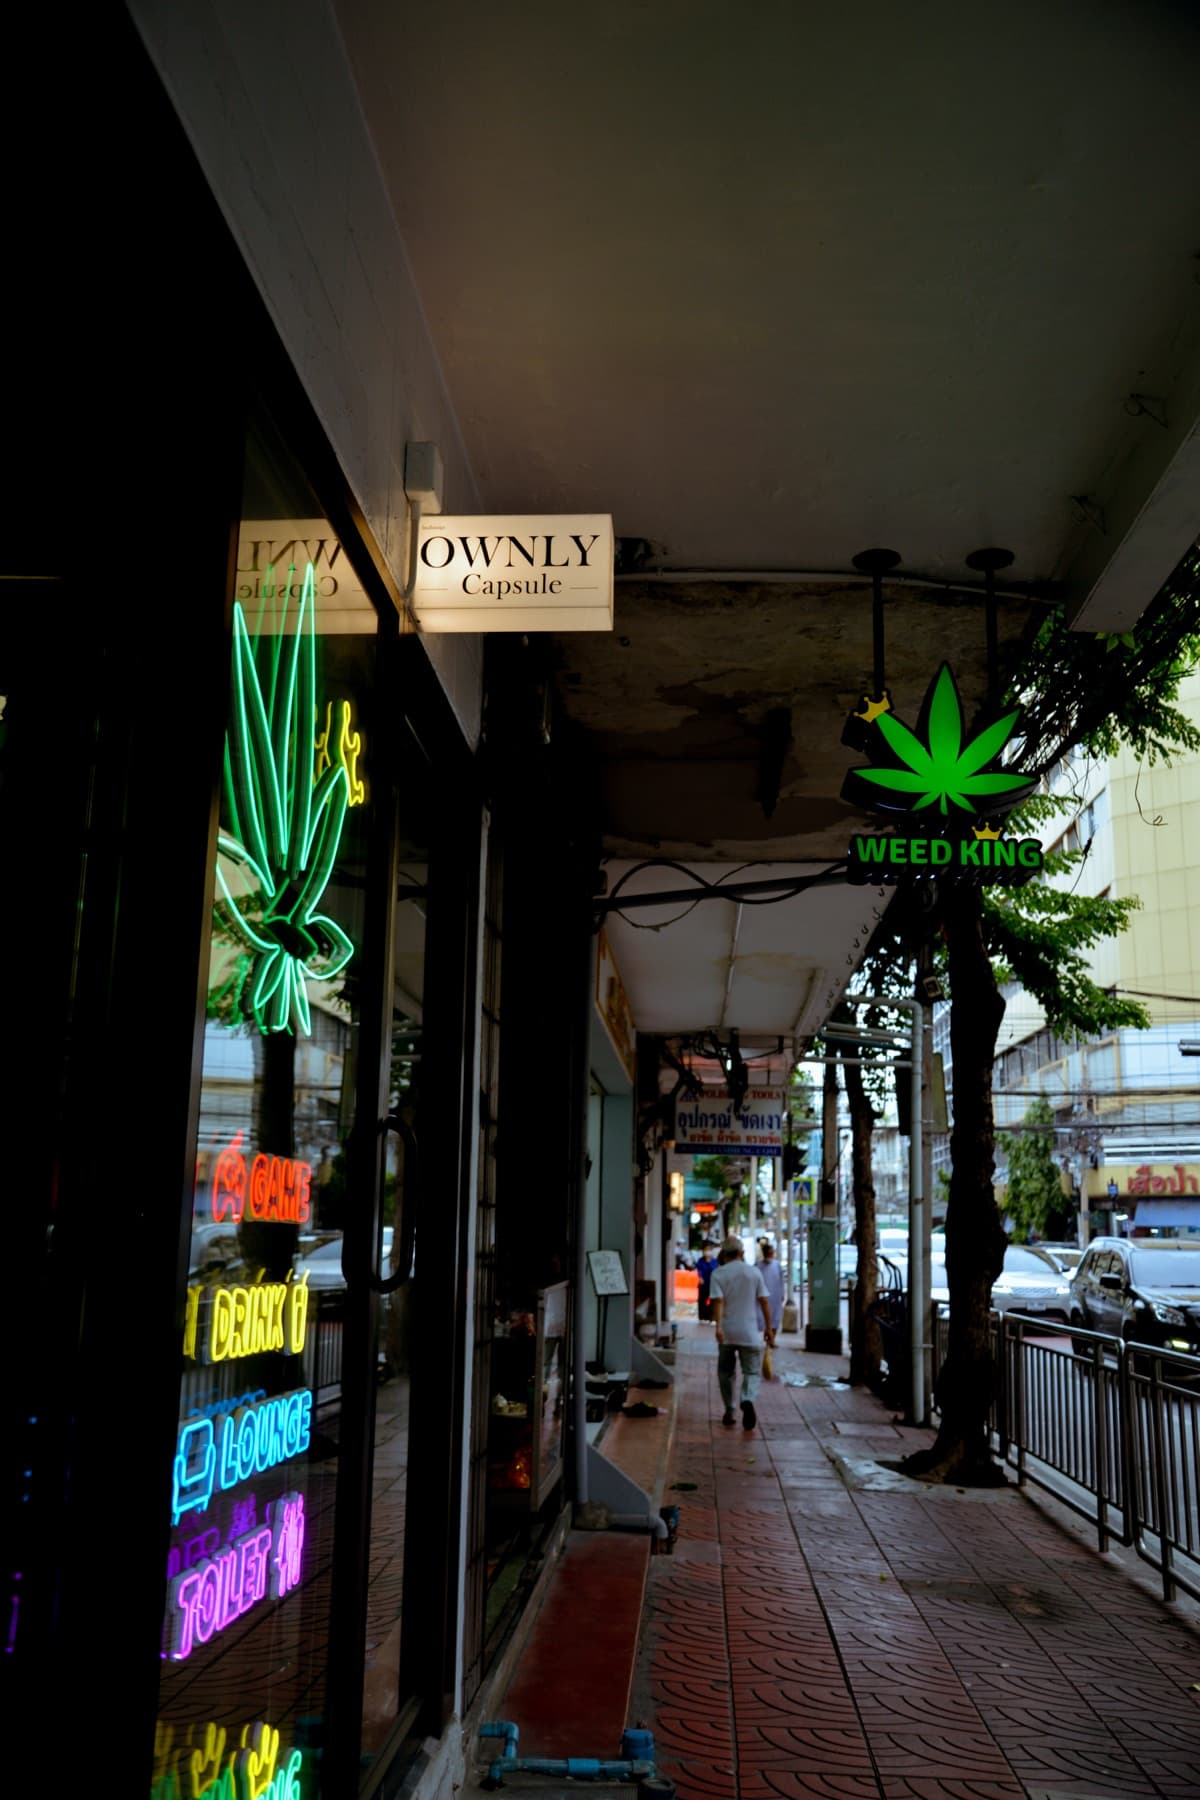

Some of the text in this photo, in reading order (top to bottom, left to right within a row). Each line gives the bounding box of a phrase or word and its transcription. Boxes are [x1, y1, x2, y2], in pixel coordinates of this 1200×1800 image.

[421, 535, 600, 568] OWNLY
[462, 573, 562, 600] Capsule
[856, 837, 1041, 867] WEED KING
[678, 1102, 732, 1138] อุปกรณ์
[251, 1152, 312, 1223] GAME
[211, 1284, 287, 1362] DRINK
[220, 1389, 312, 1490] LOUNGE
[173, 1528, 272, 1660] TOILET
